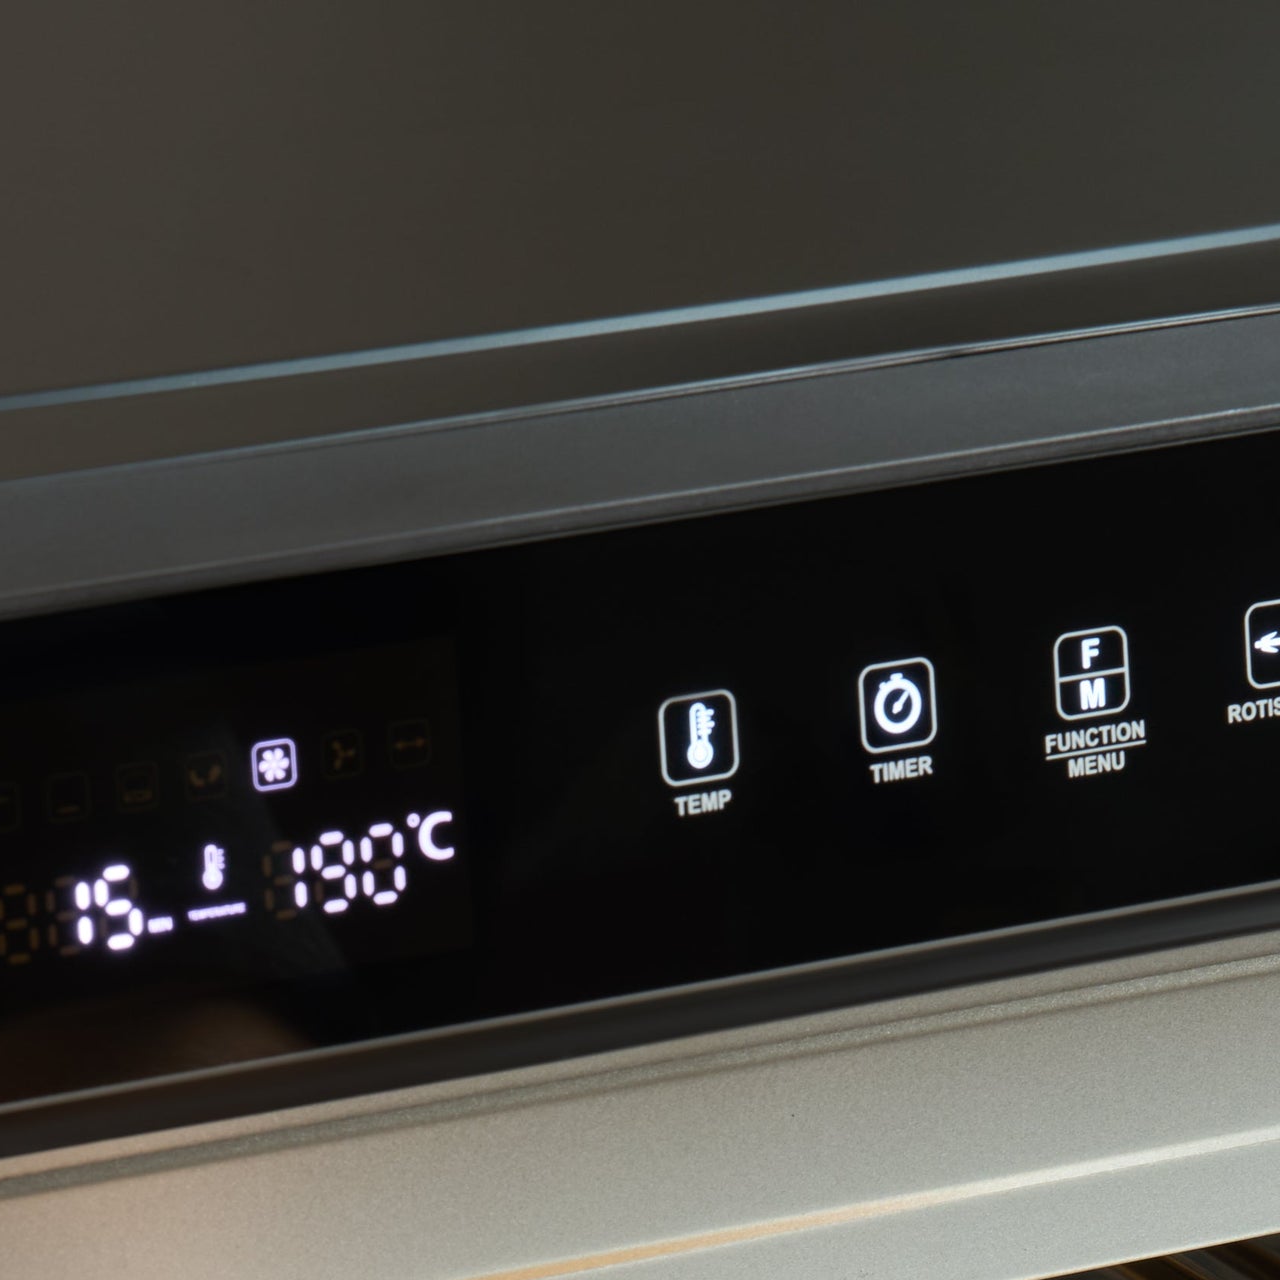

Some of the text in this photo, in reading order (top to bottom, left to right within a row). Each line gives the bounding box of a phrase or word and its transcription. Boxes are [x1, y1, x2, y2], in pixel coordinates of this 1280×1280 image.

[1080, 636, 1101, 670] F
[1079, 677, 1106, 711] M
[1045, 719, 1146, 753] FUNCTION
[870, 756, 933, 783] TIMER
[1067, 751, 1126, 778] MENU
[673, 788, 732, 816] TEMP
[74, 864, 144, 951] 15
